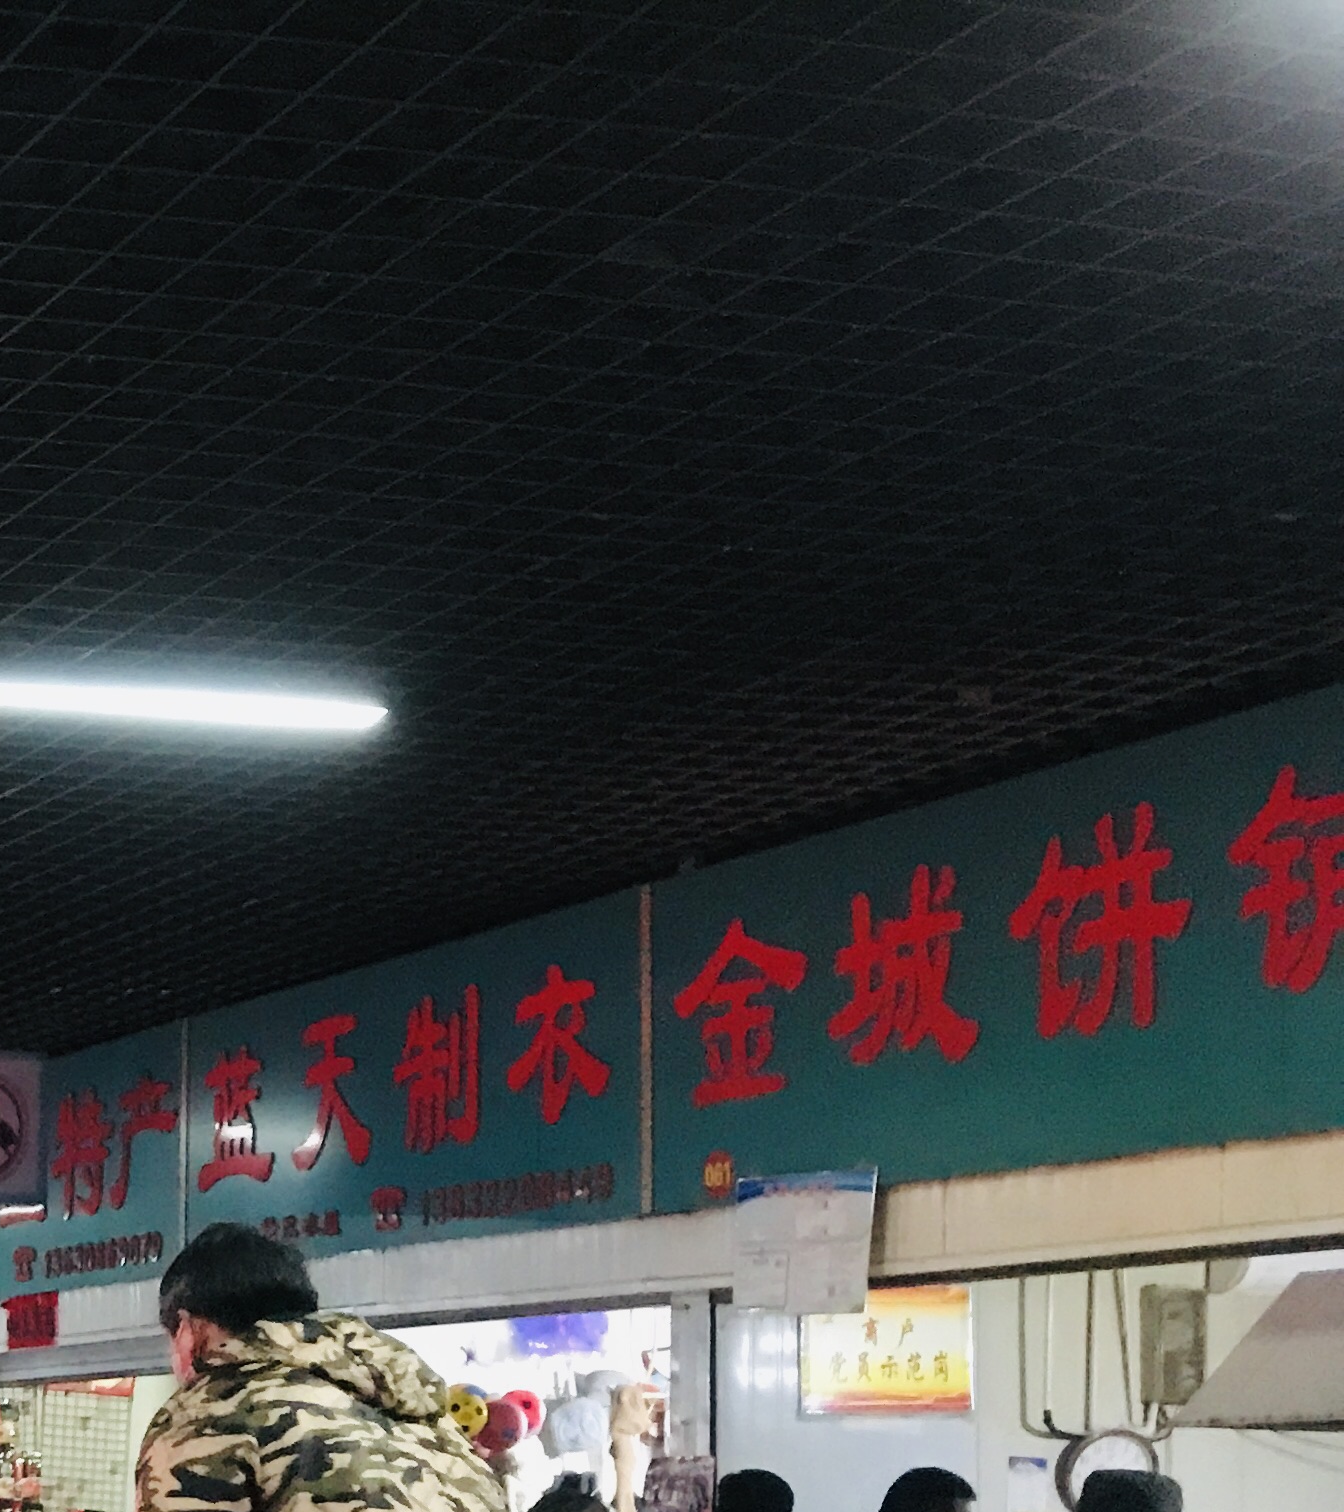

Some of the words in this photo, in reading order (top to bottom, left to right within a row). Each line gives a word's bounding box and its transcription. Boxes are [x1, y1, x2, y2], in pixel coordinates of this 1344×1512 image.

[197, 964, 612, 1193] 蓝天制衣
[829, 1350, 949, 1384] 党员示范岗
